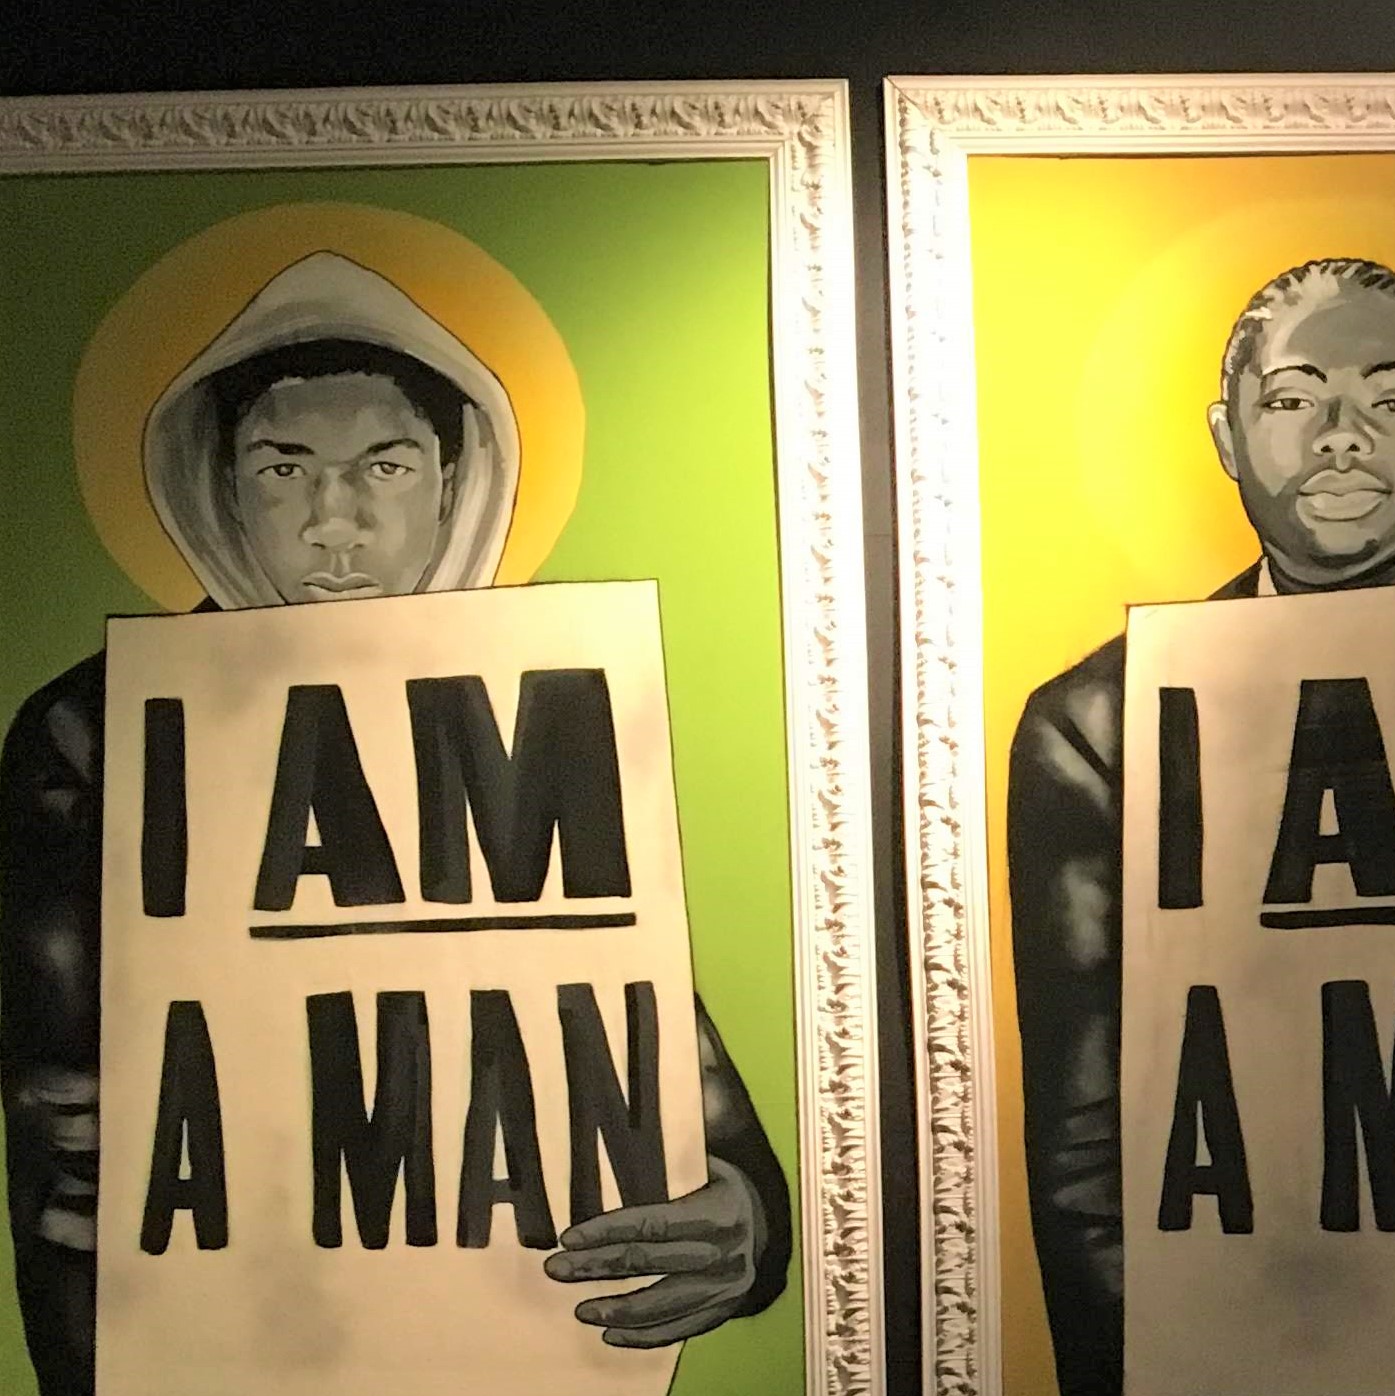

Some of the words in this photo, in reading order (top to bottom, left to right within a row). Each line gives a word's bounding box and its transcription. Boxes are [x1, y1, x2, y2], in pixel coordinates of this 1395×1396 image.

[141, 698, 187, 917] I
[253, 668, 633, 912] AM
[1158, 687, 1203, 909] I
[140, 1001, 229, 1255] A
[306, 981, 670, 1251] MAN
[1157, 985, 1254, 1234] A
